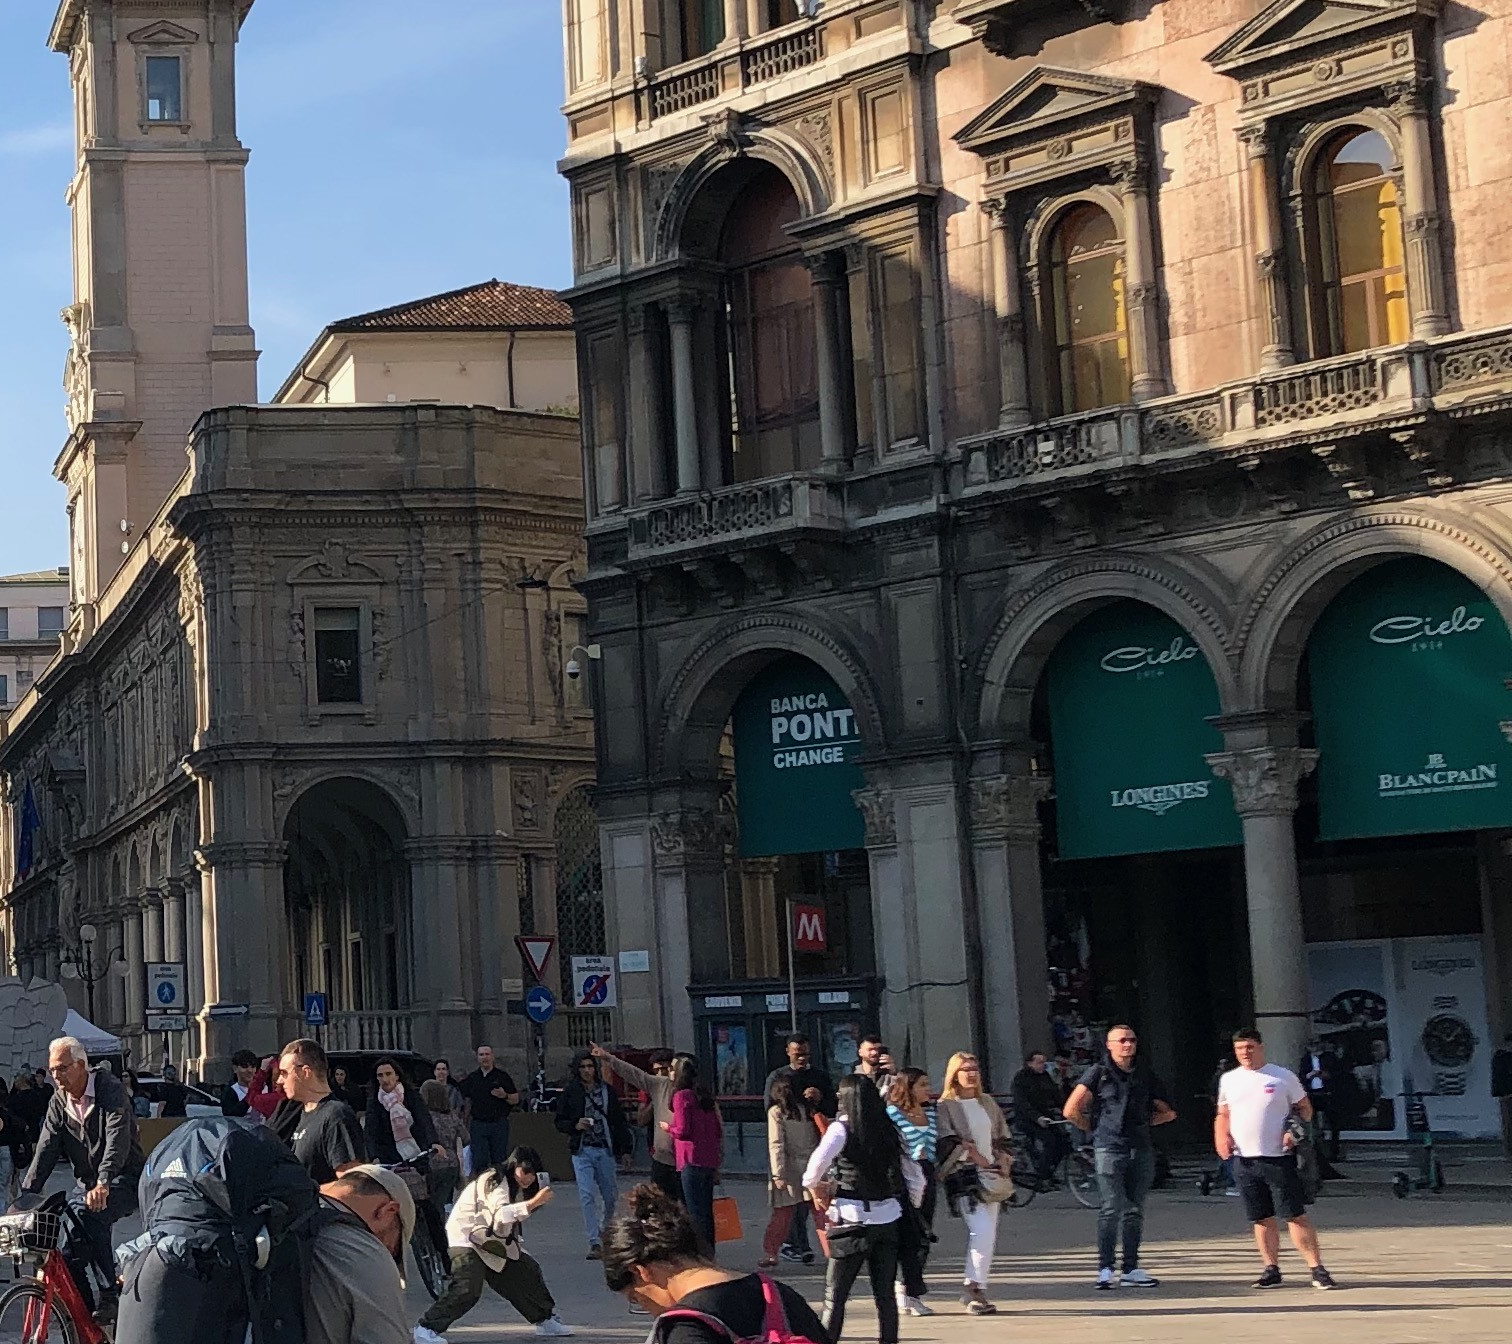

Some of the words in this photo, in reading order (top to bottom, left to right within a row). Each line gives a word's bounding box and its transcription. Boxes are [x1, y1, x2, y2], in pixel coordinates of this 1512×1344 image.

[1369, 606, 1485, 644] Cielo
[1101, 637, 1199, 672] Cielo
[771, 693, 828, 713] BANCA
[774, 747, 843, 768] CHANGE
[1378, 764, 1497, 789] BLANCPAIN
[1110, 780, 1212, 807] LONGINES
[797, 913, 823, 941] M
